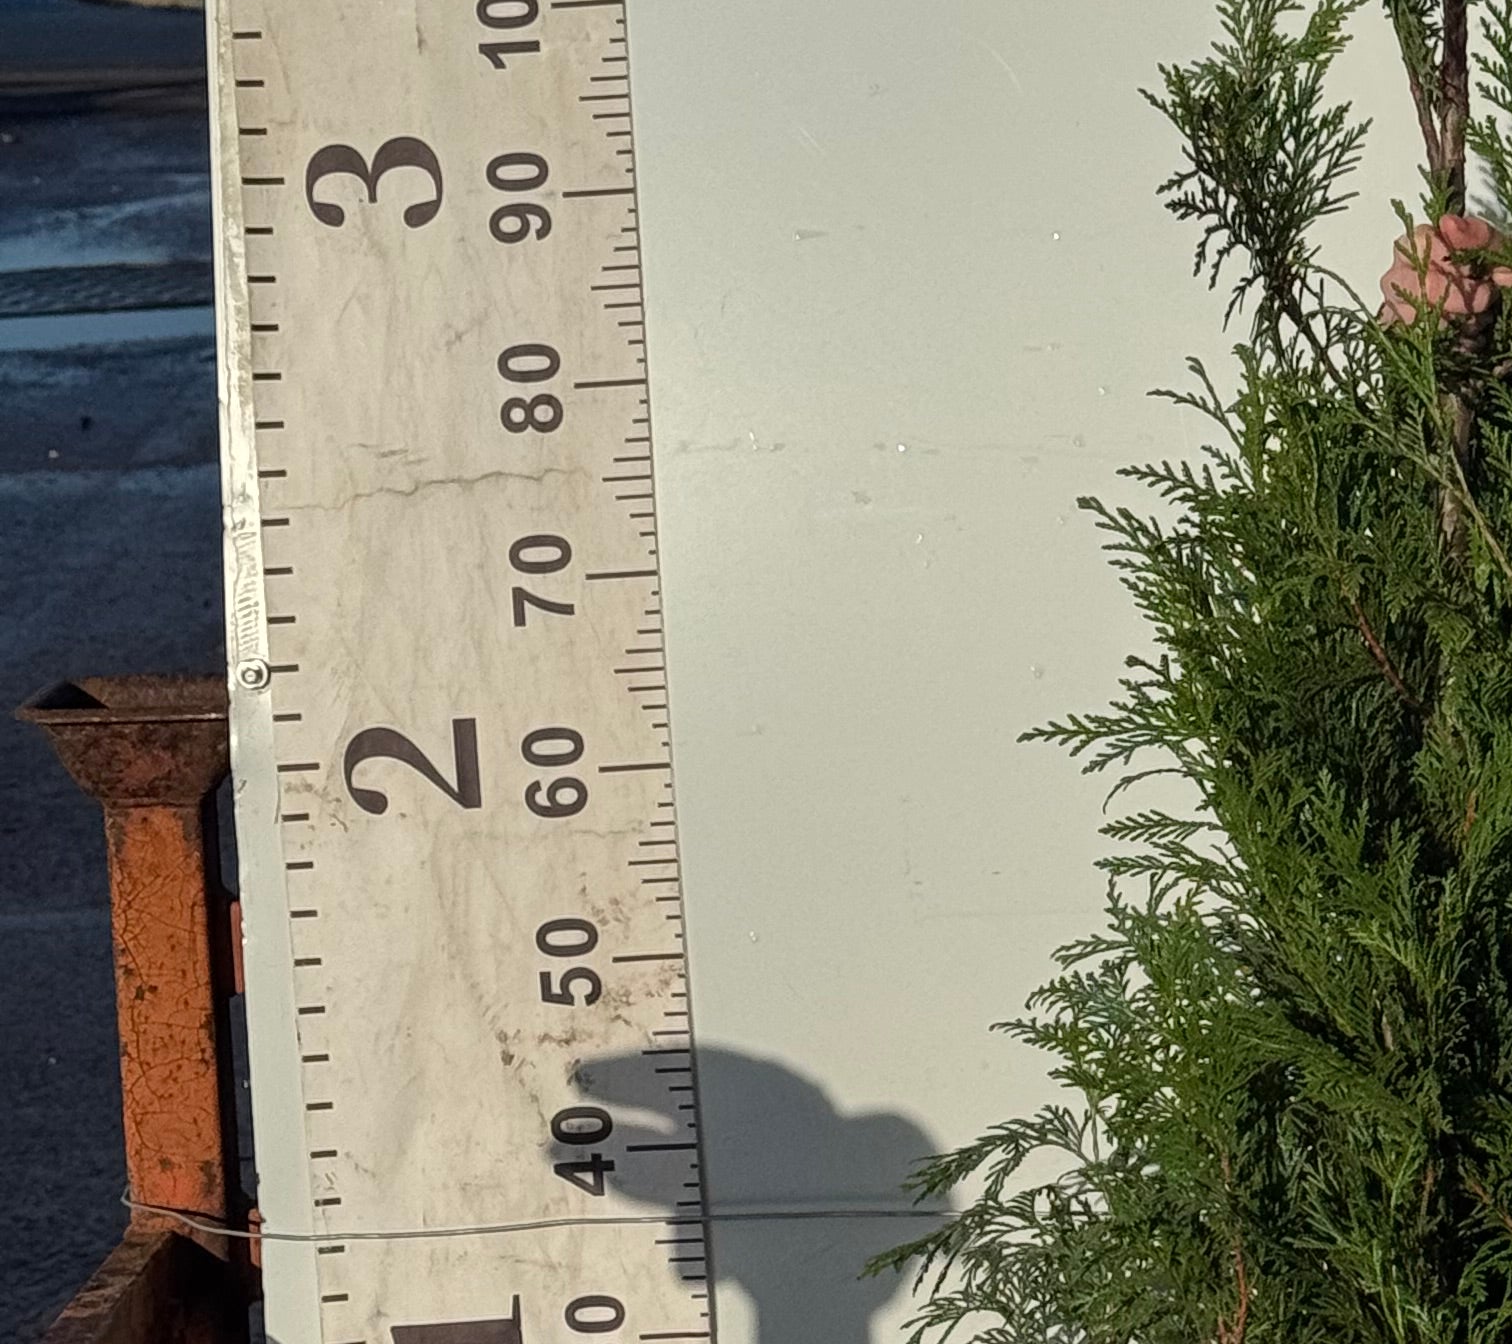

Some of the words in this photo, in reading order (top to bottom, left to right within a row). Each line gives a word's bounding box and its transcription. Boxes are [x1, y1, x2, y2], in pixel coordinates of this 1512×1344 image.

[305, 136, 443, 229] 3
[485, 151, 553, 244] 90
[497, 342, 564, 434] 80
[508, 533, 575, 628] 70
[343, 717, 482, 816] 2
[521, 726, 590, 819] 60
[535, 916, 601, 1008] 50
[550, 1105, 617, 1197] 40
